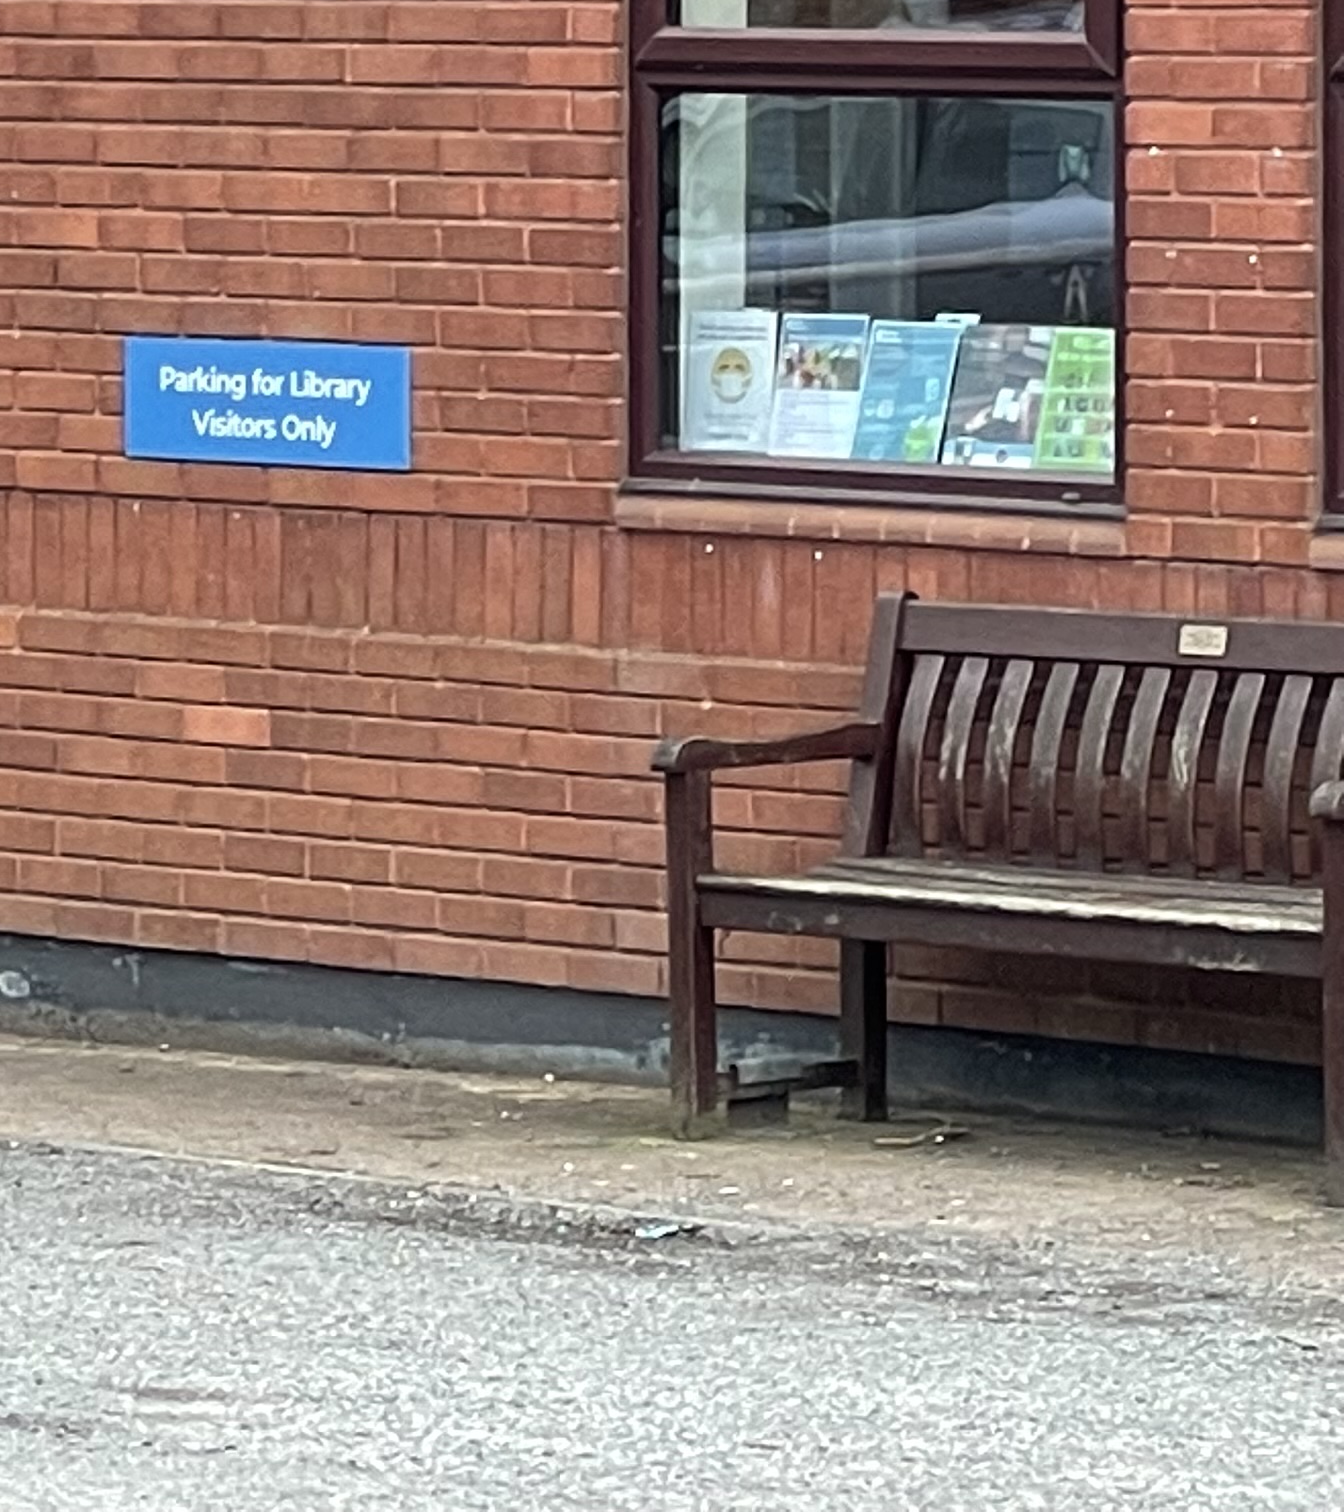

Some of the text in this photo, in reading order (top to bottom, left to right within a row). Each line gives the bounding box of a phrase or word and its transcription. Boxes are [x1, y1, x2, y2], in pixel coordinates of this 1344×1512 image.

[159, 365, 371, 406] Parking for Library
[192, 408, 336, 449] Visitors Only
